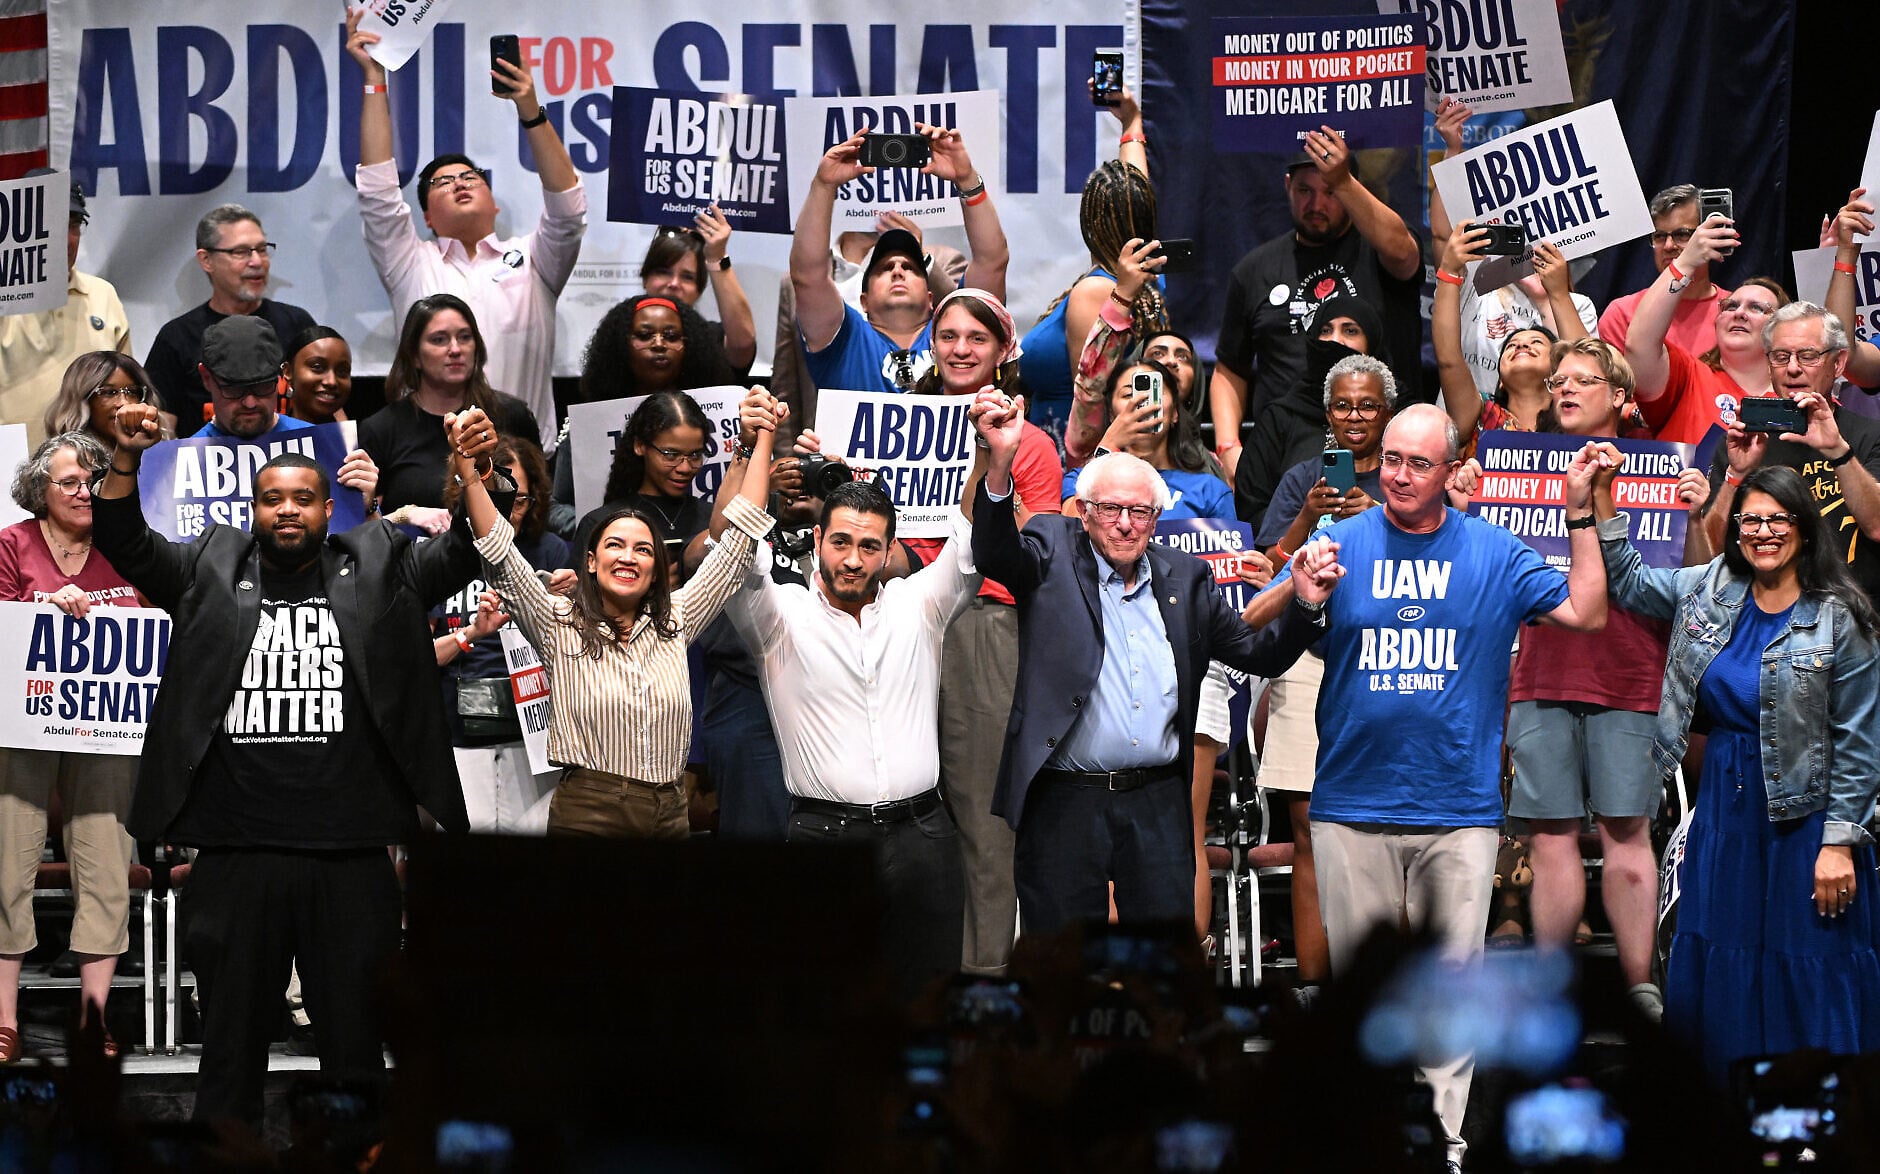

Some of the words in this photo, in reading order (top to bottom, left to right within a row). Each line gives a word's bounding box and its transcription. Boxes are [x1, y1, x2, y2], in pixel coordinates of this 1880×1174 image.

[1224, 34, 1280, 54] MONEY
[1285, 31, 1316, 53] OUT
[1321, 30, 1341, 51] OF
[1346, 25, 1414, 49] POLITICS
[1417, 0, 1528, 51] BDUL
[519, 36, 614, 96] FOR
[1225, 60, 1280, 81] MONEY
[1286, 60, 1303, 79] IN
[1309, 57, 1350, 78] YOUR
[1356, 51, 1414, 75] POCKET
[1427, 51, 1533, 94] SENATE
[1225, 86, 1328, 116] MEDICARE
[1336, 84, 1372, 112] FOR
[1379, 79, 1413, 107] ALL
[644, 97, 781, 162] ABDUL
[644, 175, 671, 194] US
[674, 158, 779, 204] SENATE
[645, 158, 672, 176] FOR
[1465, 122, 1598, 217] ABDUL
[573, 269, 598, 279] ABDUL
[599, 269, 614, 279] FOR
[847, 401, 970, 462] ABDUL
[173, 436, 316, 499] ABD
[1485, 448, 1545, 471] MONEY
[1619, 453, 1680, 475] OLITICS
[1482, 477, 1543, 500] MONEY
[1544, 479, 1562, 500] IN
[1616, 481, 1677, 505] POCKET
[176, 504, 204, 517] FOR
[176, 516, 206, 537] US
[1479, 506, 1569, 538] MEDICA
[1636, 511, 1672, 541] ALL
[1169, 530, 1243, 554] POLITICS
[1372, 559, 1452, 600] UAW
[1402, 609, 1419, 617] FOR
[510, 645, 533, 669] MONEY
[1358, 627, 1459, 671] ABDUL
[241, 646, 344, 689] OTERS
[1369, 674, 1395, 691] U.S.
[1397, 673, 1445, 691] SENATE
[26, 679, 55, 696] FOR
[516, 672, 542, 697] MONEY
[25, 694, 53, 716] US
[58, 679, 159, 724] SENAT
[224, 690, 344, 734] MATTER
[43, 726, 144, 740] AbdulForSenate.co
